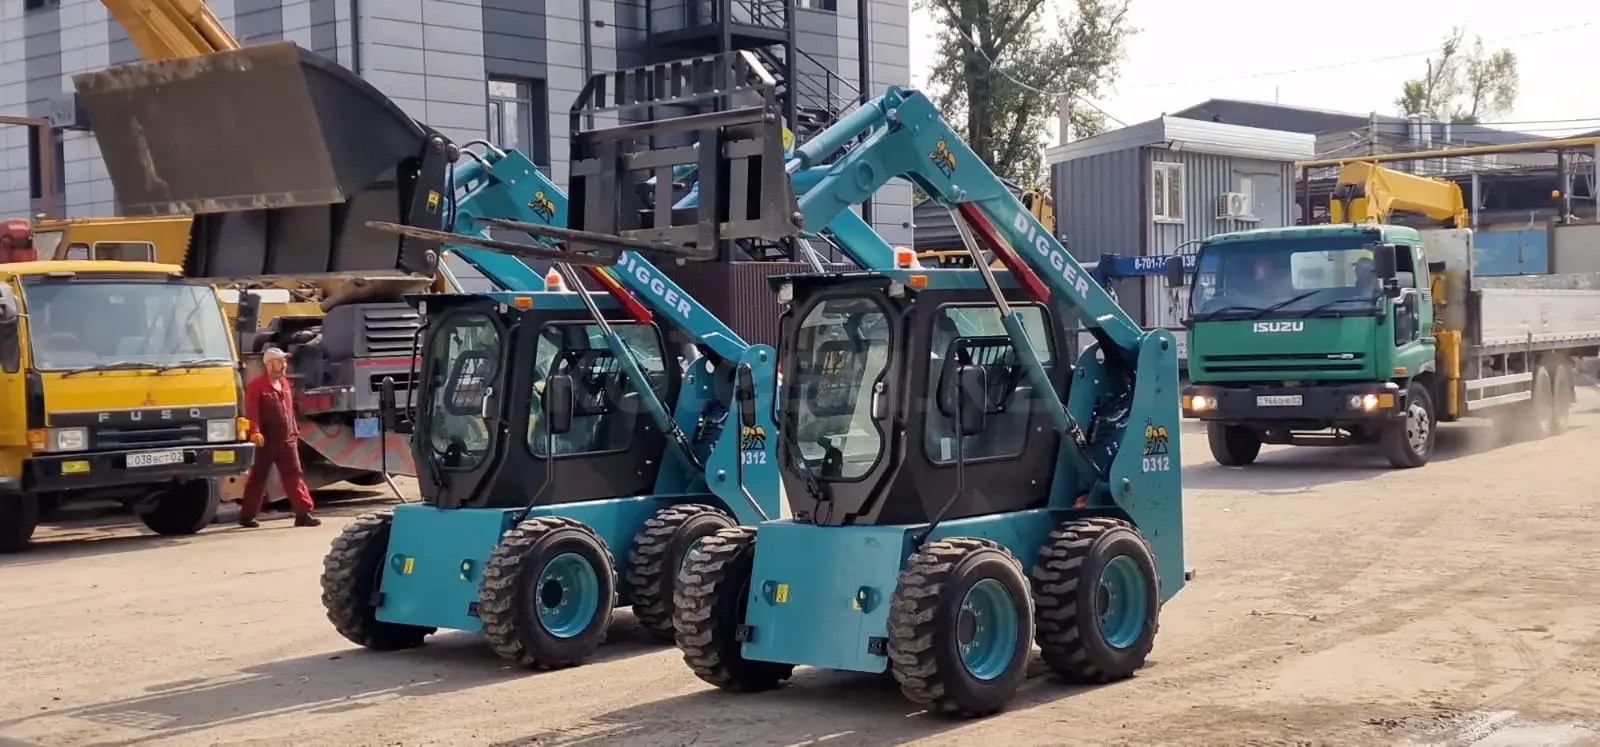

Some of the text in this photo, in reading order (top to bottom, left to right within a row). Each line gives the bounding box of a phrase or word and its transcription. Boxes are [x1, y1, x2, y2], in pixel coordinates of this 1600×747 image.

[1014, 212, 1089, 299] DIGGER
[1253, 321, 1304, 333] ISUZU
[99, 408, 200, 422] FUSO
[1142, 456, 1170, 473] D312
